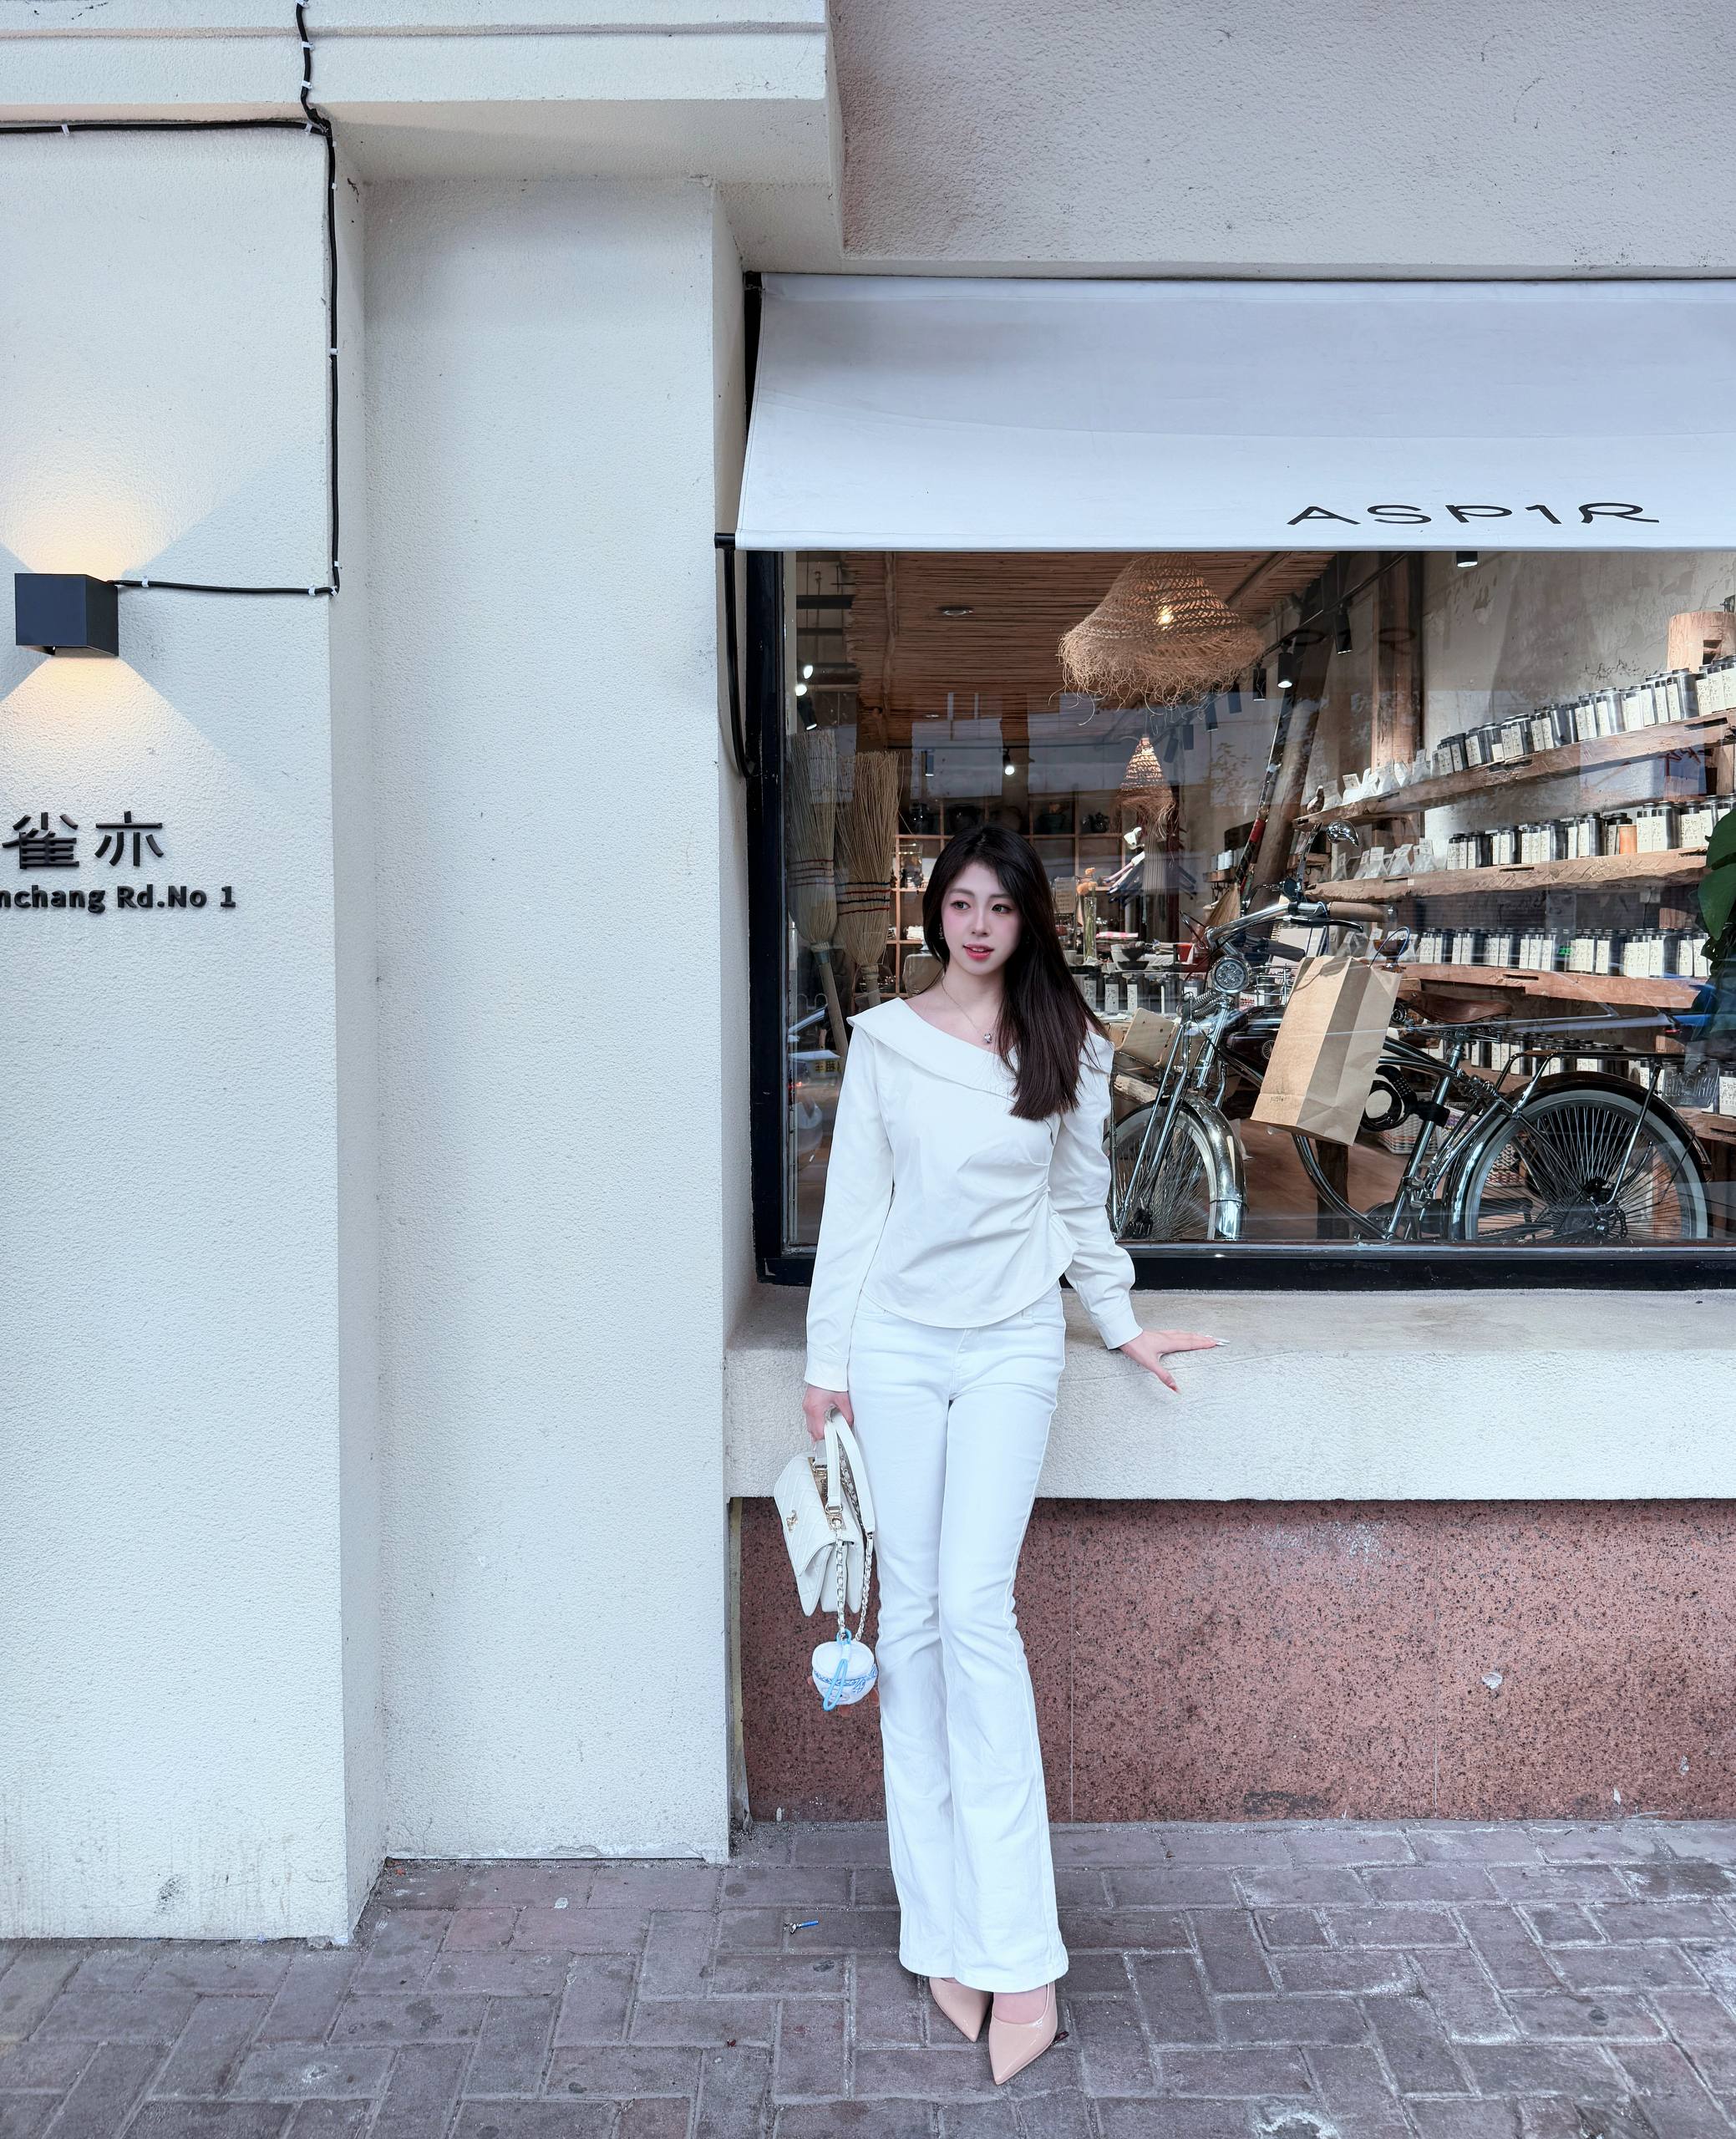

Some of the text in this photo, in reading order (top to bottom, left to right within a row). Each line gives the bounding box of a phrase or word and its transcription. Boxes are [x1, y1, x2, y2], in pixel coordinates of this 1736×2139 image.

[2, 810, 165, 869] 雀亦
[0, 884, 106, 914] nchang
[220, 886, 236, 908] 1
